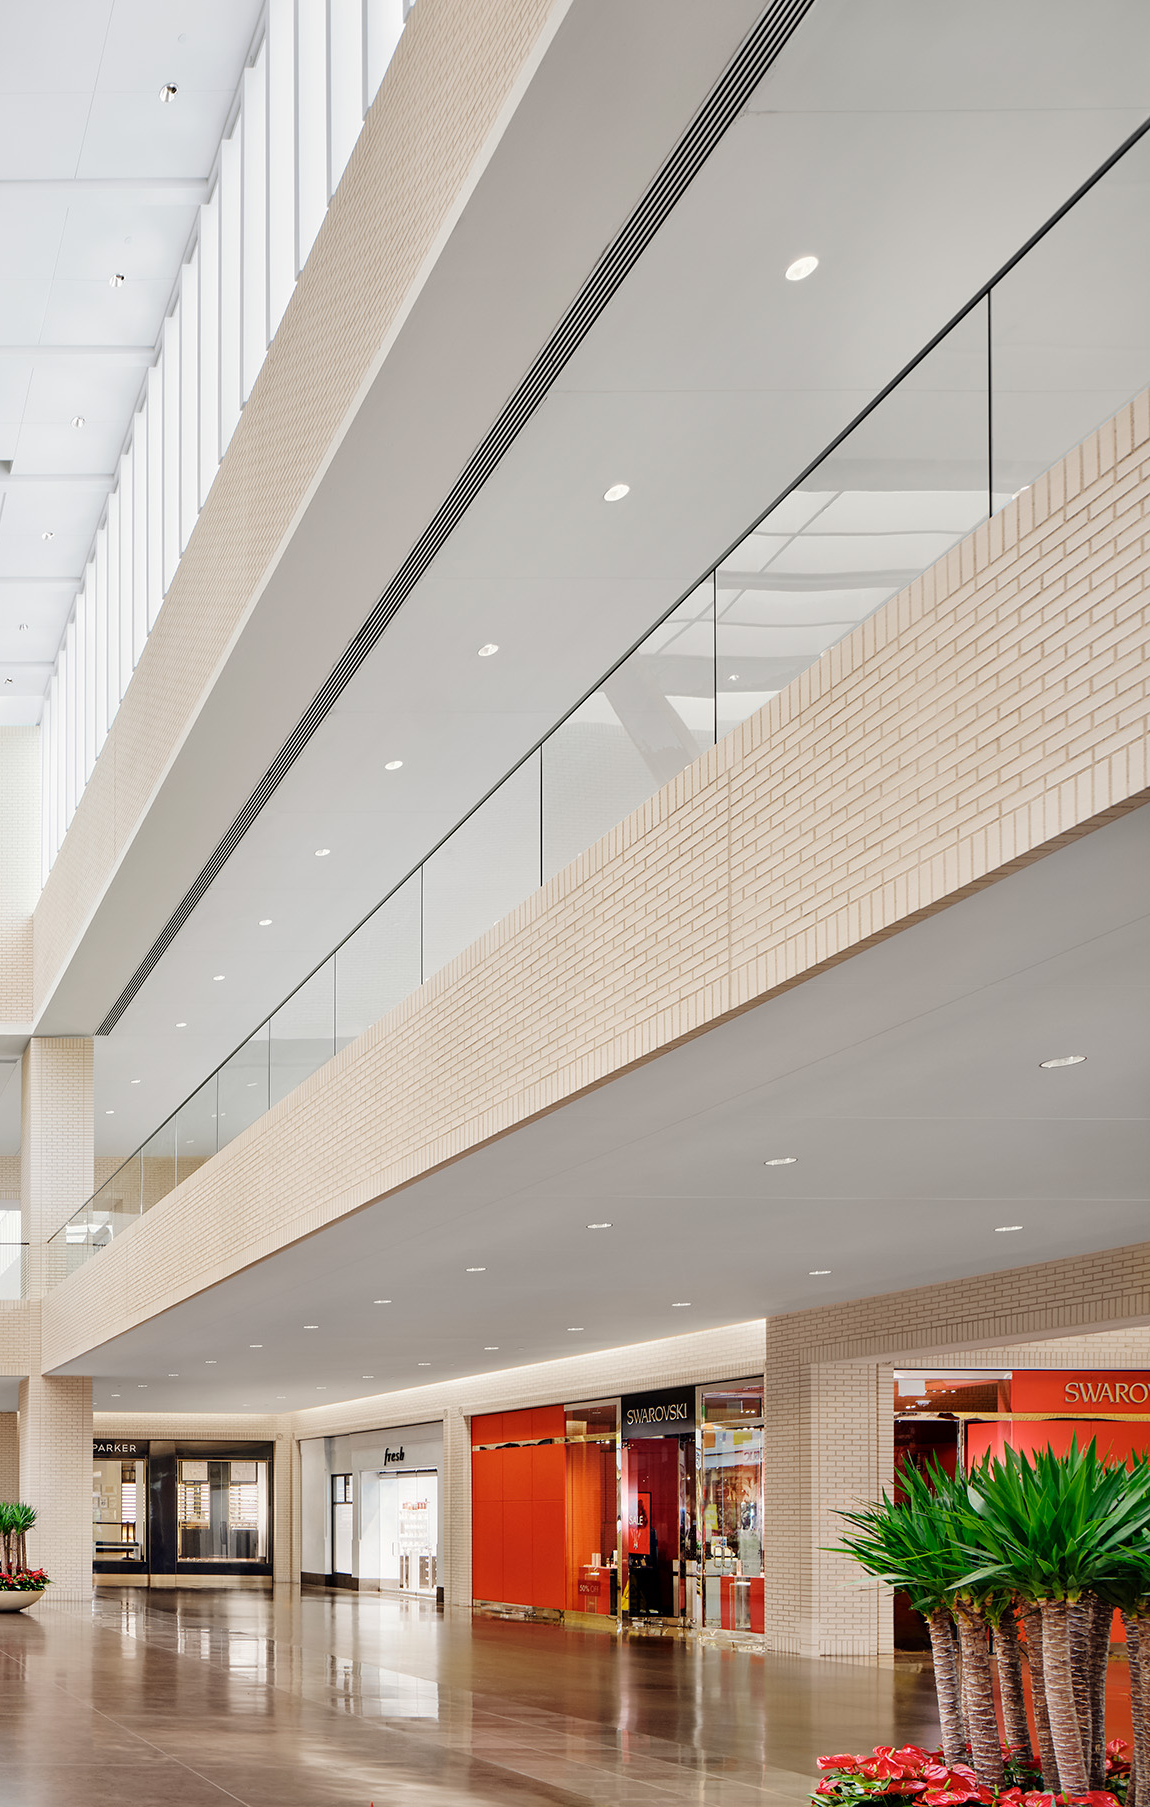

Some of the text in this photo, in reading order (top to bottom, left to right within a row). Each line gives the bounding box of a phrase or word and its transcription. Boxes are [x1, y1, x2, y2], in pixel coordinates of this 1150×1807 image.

[1064, 1382, 1150, 1404] SWARO
[626, 1402, 687, 1426] SWAROVSKI
[92, 1443, 137, 1453] PARKER
[383, 1446, 405, 1466] fresh
[628, 1515, 643, 1526] SALE
[579, 1584, 590, 1593] 50%
